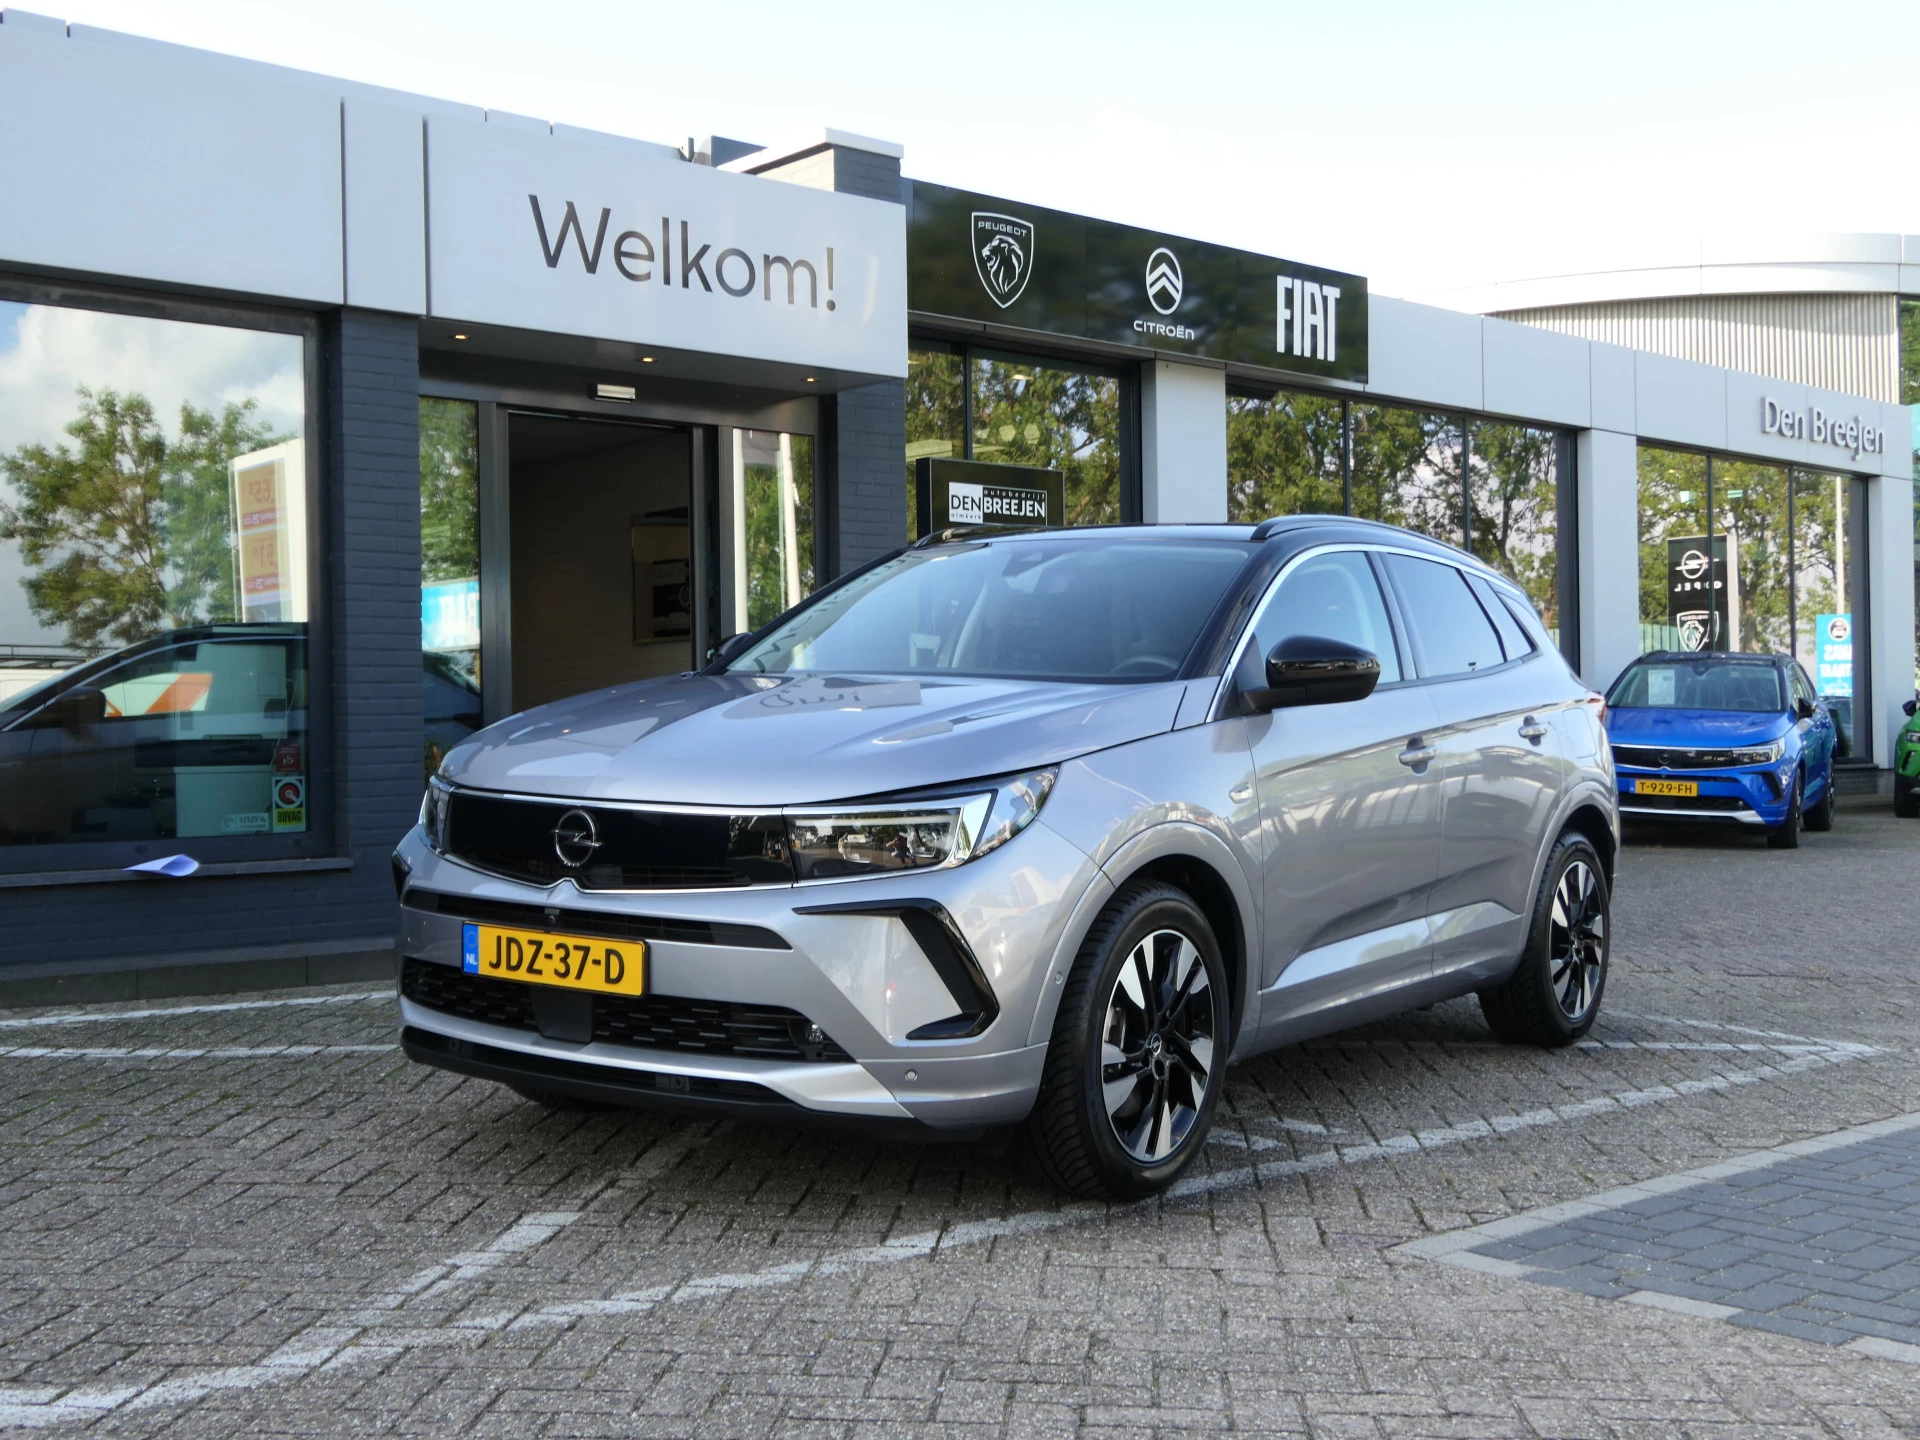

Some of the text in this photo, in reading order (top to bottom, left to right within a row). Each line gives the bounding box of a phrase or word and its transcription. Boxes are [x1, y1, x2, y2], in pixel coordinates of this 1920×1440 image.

[978, 220, 1028, 238] PEUGEOT
[528, 193, 836, 312] Welkom!
[1276, 275, 1341, 363] FIAT
[1133, 319, 1195, 341] CITROËN
[1760, 396, 1886, 461] Den Breejen
[983, 489, 1046, 501] autobedrijf
[950, 494, 1046, 518] DEN BREEJEN
[950, 512, 982, 521] almkerk
[1639, 781, 1693, 795] T-929-FH
[277, 810, 302, 824] BOVAG
[466, 952, 478, 966] NL
[488, 935, 625, 985] JDZ-37-D
